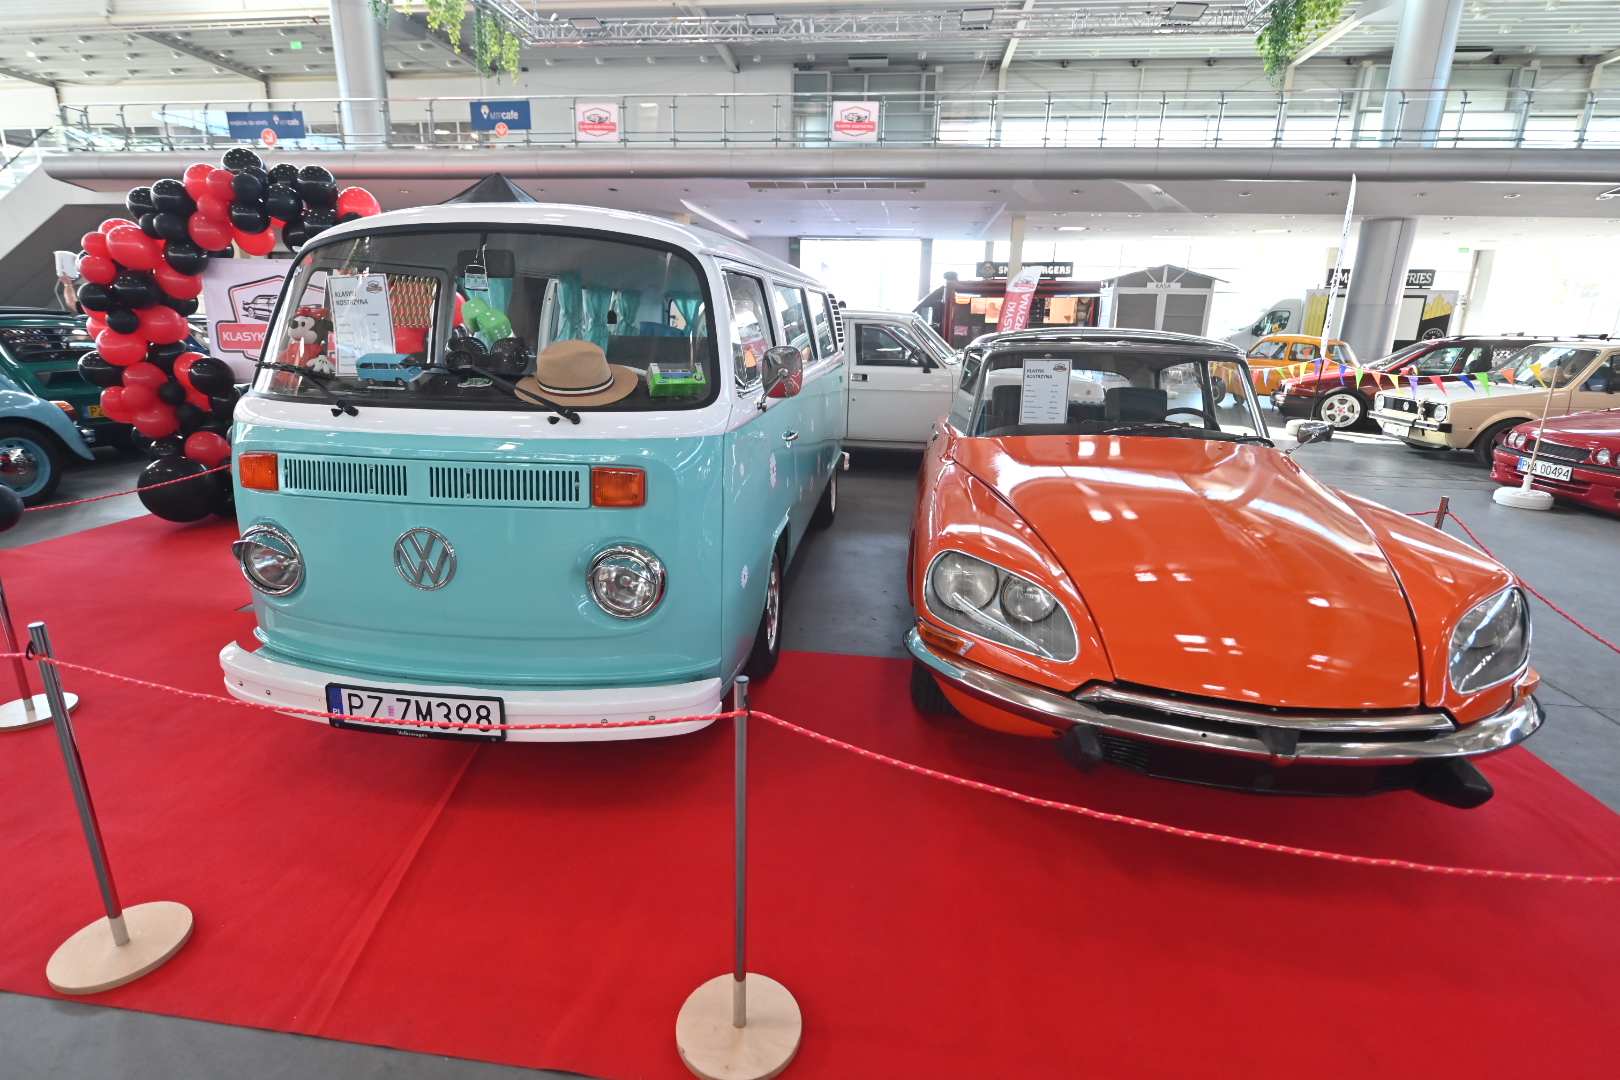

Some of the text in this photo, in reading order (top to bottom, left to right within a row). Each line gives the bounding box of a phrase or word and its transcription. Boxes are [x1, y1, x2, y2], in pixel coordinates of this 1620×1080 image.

[1002, 301, 1017, 332] ASYKI
[1014, 293, 1031, 331] RZYNA
[222, 331, 265, 342] KLASYK
[1540, 463, 1570, 480] 00494
[396, 698, 492, 732] 7M398
